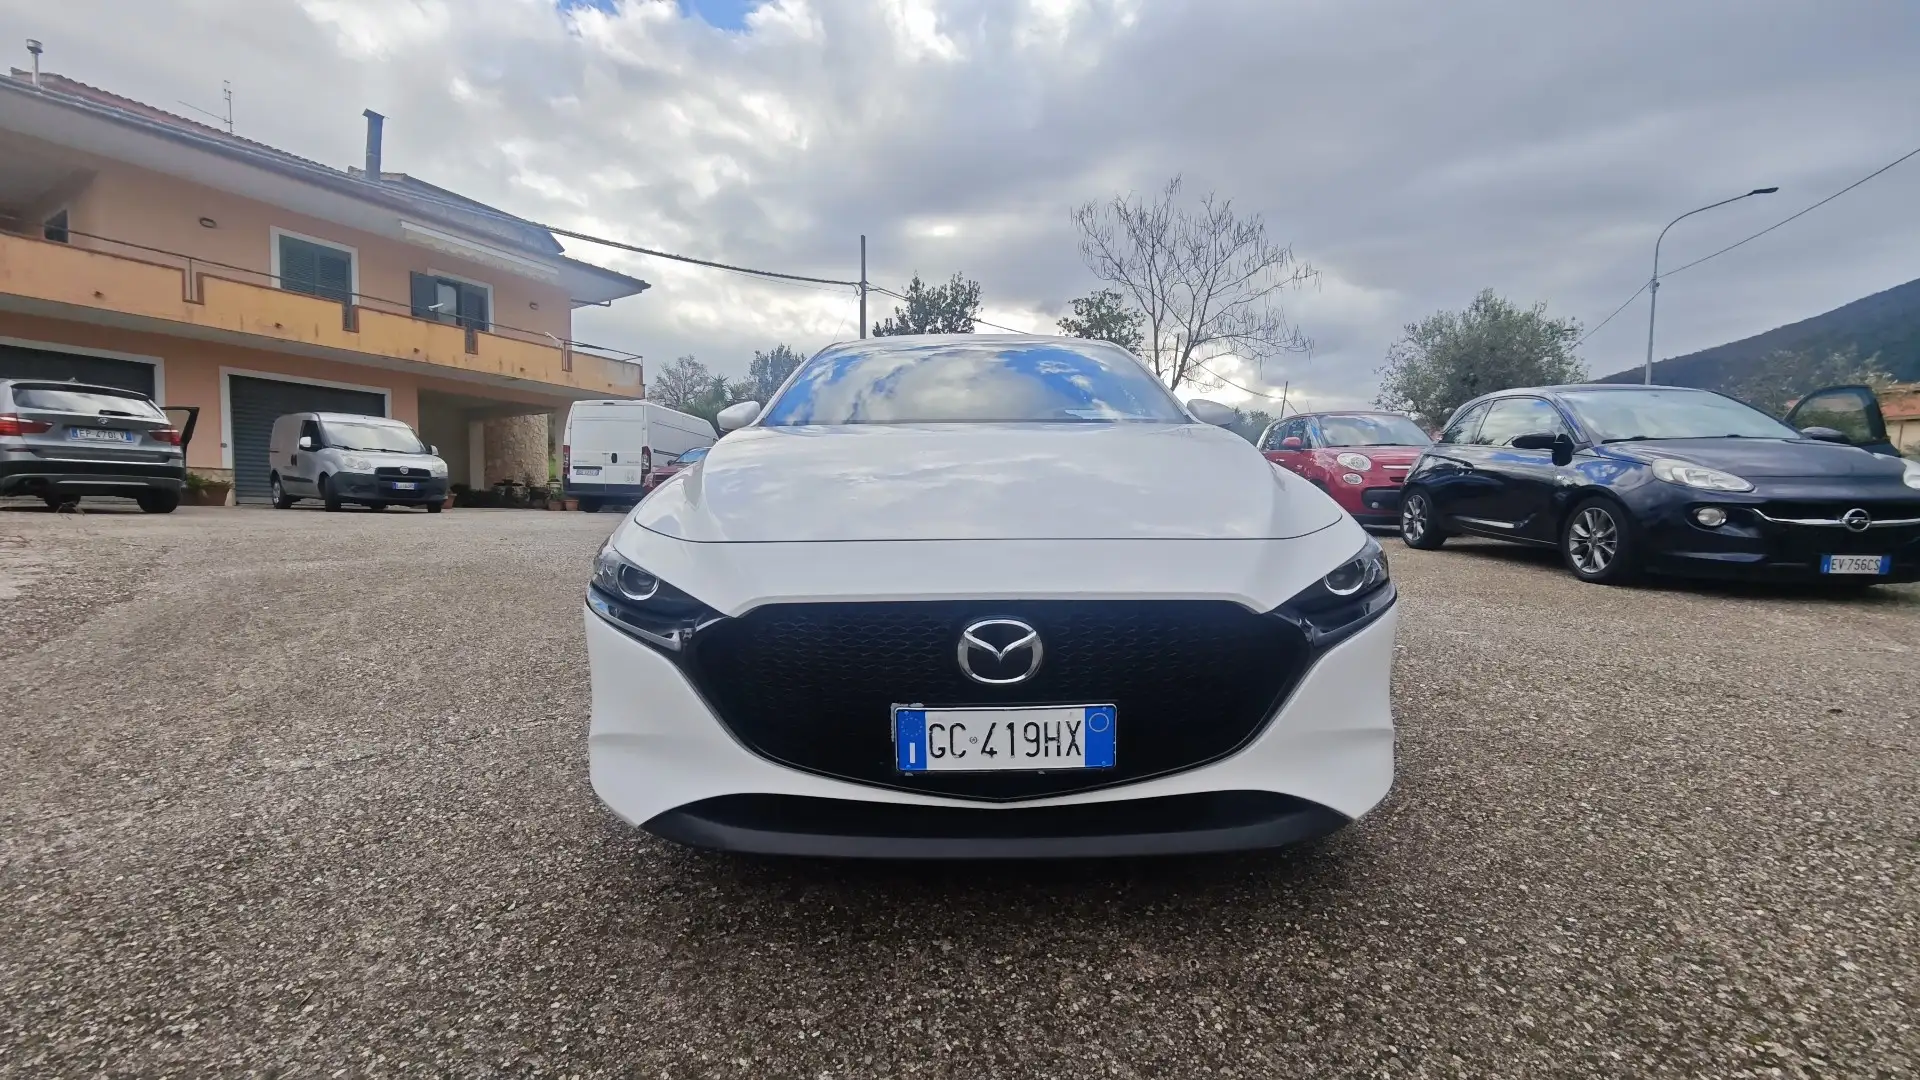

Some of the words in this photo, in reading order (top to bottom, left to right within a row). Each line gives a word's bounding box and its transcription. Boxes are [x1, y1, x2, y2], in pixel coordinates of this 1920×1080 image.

[1831, 558, 1845, 571] EV
[1847, 558, 1881, 571] 756CS
[928, 722, 967, 759] GC
[980, 720, 1082, 759] 419HX
